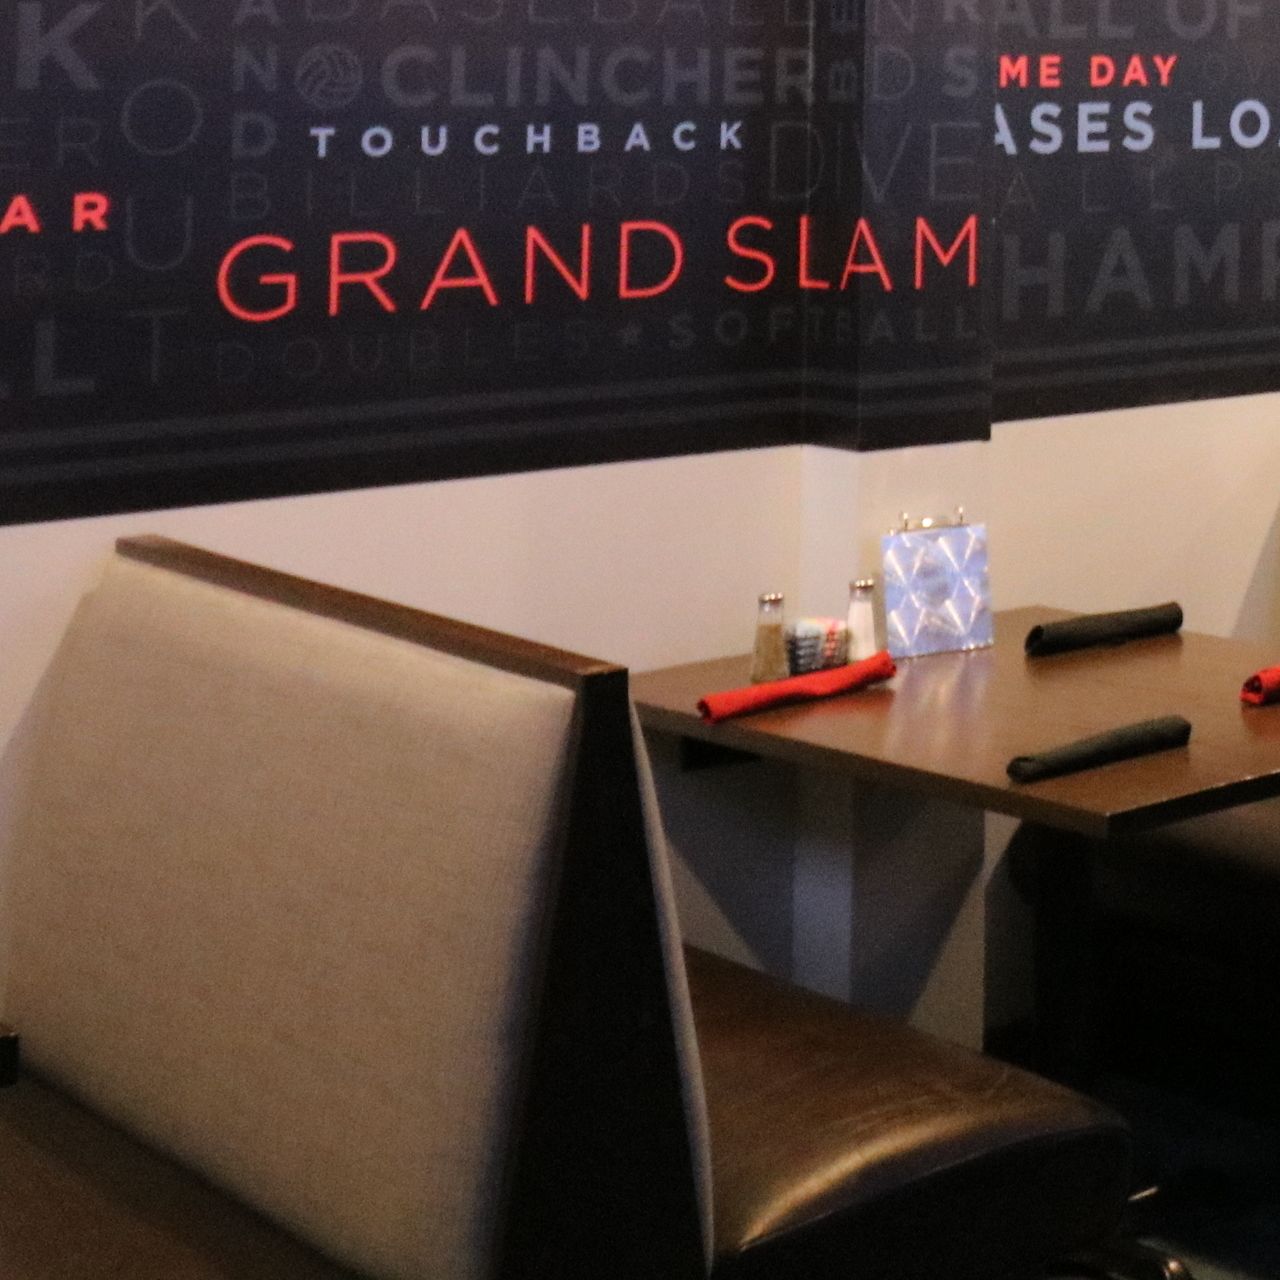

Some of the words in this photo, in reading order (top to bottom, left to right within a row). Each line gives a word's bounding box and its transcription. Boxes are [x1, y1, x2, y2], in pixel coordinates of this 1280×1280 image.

[1089, 53, 1180, 88] DAY
[307, 120, 746, 160] TOUCHBACK
[215, 218, 687, 323] GRAND
[721, 213, 981, 294] SLAM
